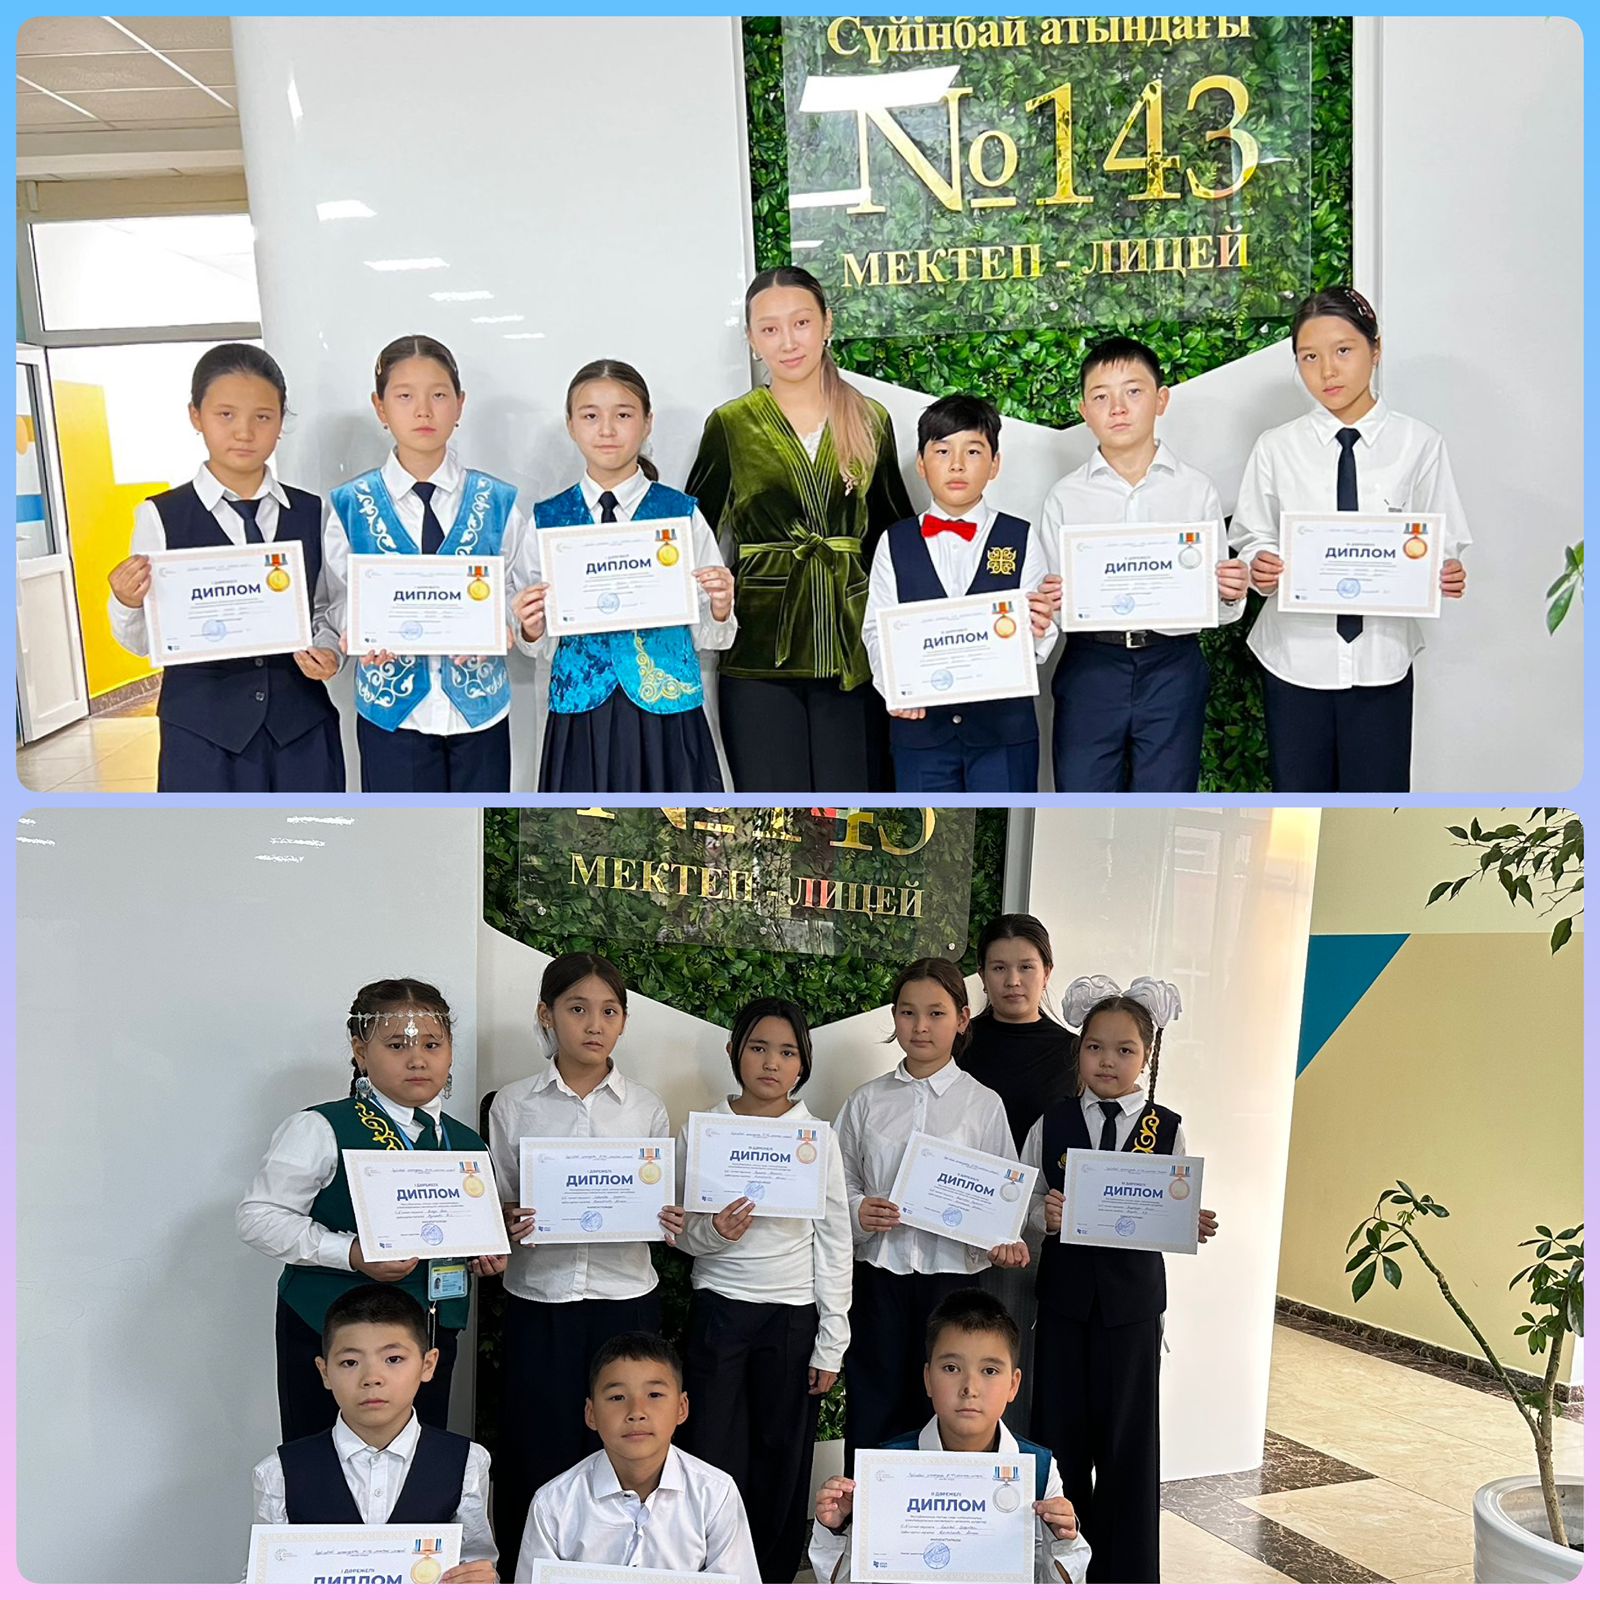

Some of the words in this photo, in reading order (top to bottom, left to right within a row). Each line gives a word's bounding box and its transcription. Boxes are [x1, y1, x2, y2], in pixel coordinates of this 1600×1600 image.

[827, 16, 1028, 64] Сүйінбай
[1040, 16, 1252, 47] атындағы
[842, 243, 1043, 288] МЕКТЕП
[1081, 226, 1251, 276] ЛИЦЕЙ
[1325, 547, 1396, 558] ДИПЛОМ
[586, 558, 652, 575] ДИПЛОМ
[1104, 560, 1172, 574] ДИПЛОМ
[191, 583, 261, 601] ДИПЛОМ
[393, 590, 462, 601] ДИПЛОМ
[923, 631, 989, 650] ДИПЛОМ
[568, 853, 755, 902] МЕКТЕП
[788, 878, 924, 920] ЛИЦЕЙ
[729, 1150, 791, 1163] ДИПЛОМ
[566, 1174, 633, 1187] ДИПЛОМ
[937, 1172, 995, 1197] ДИПЛОМ
[397, 1188, 460, 1201] ДИПЛОМ
[1103, 1185, 1163, 1199] ДИПЛОМ
[907, 1498, 986, 1512] ДИПЛОМ
